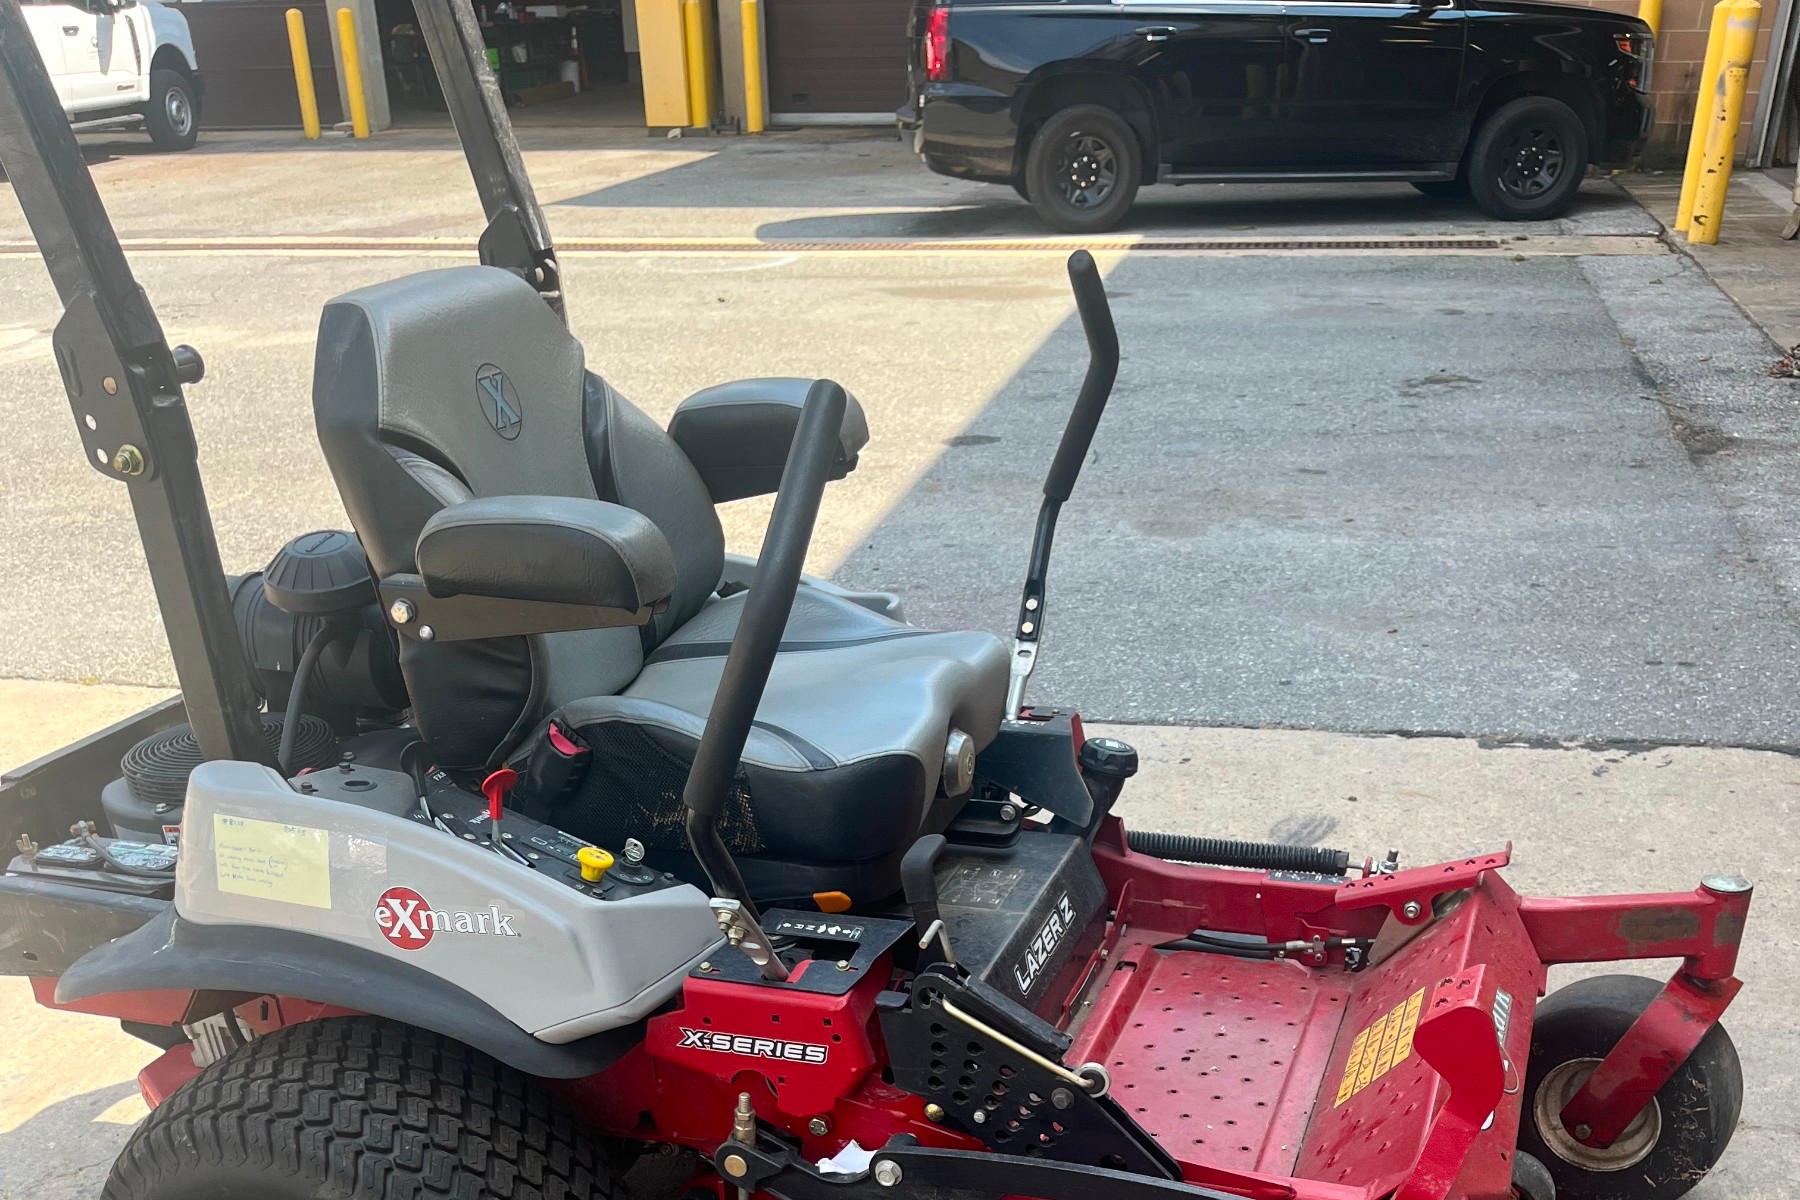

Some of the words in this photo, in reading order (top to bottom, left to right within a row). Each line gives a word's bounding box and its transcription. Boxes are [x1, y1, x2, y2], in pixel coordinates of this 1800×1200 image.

[374, 897, 517, 940] eXmark
[1015, 911, 1065, 994] LAZER
[1059, 893, 1075, 925] Z
[679, 1029, 827, 1063] X-SERIES
